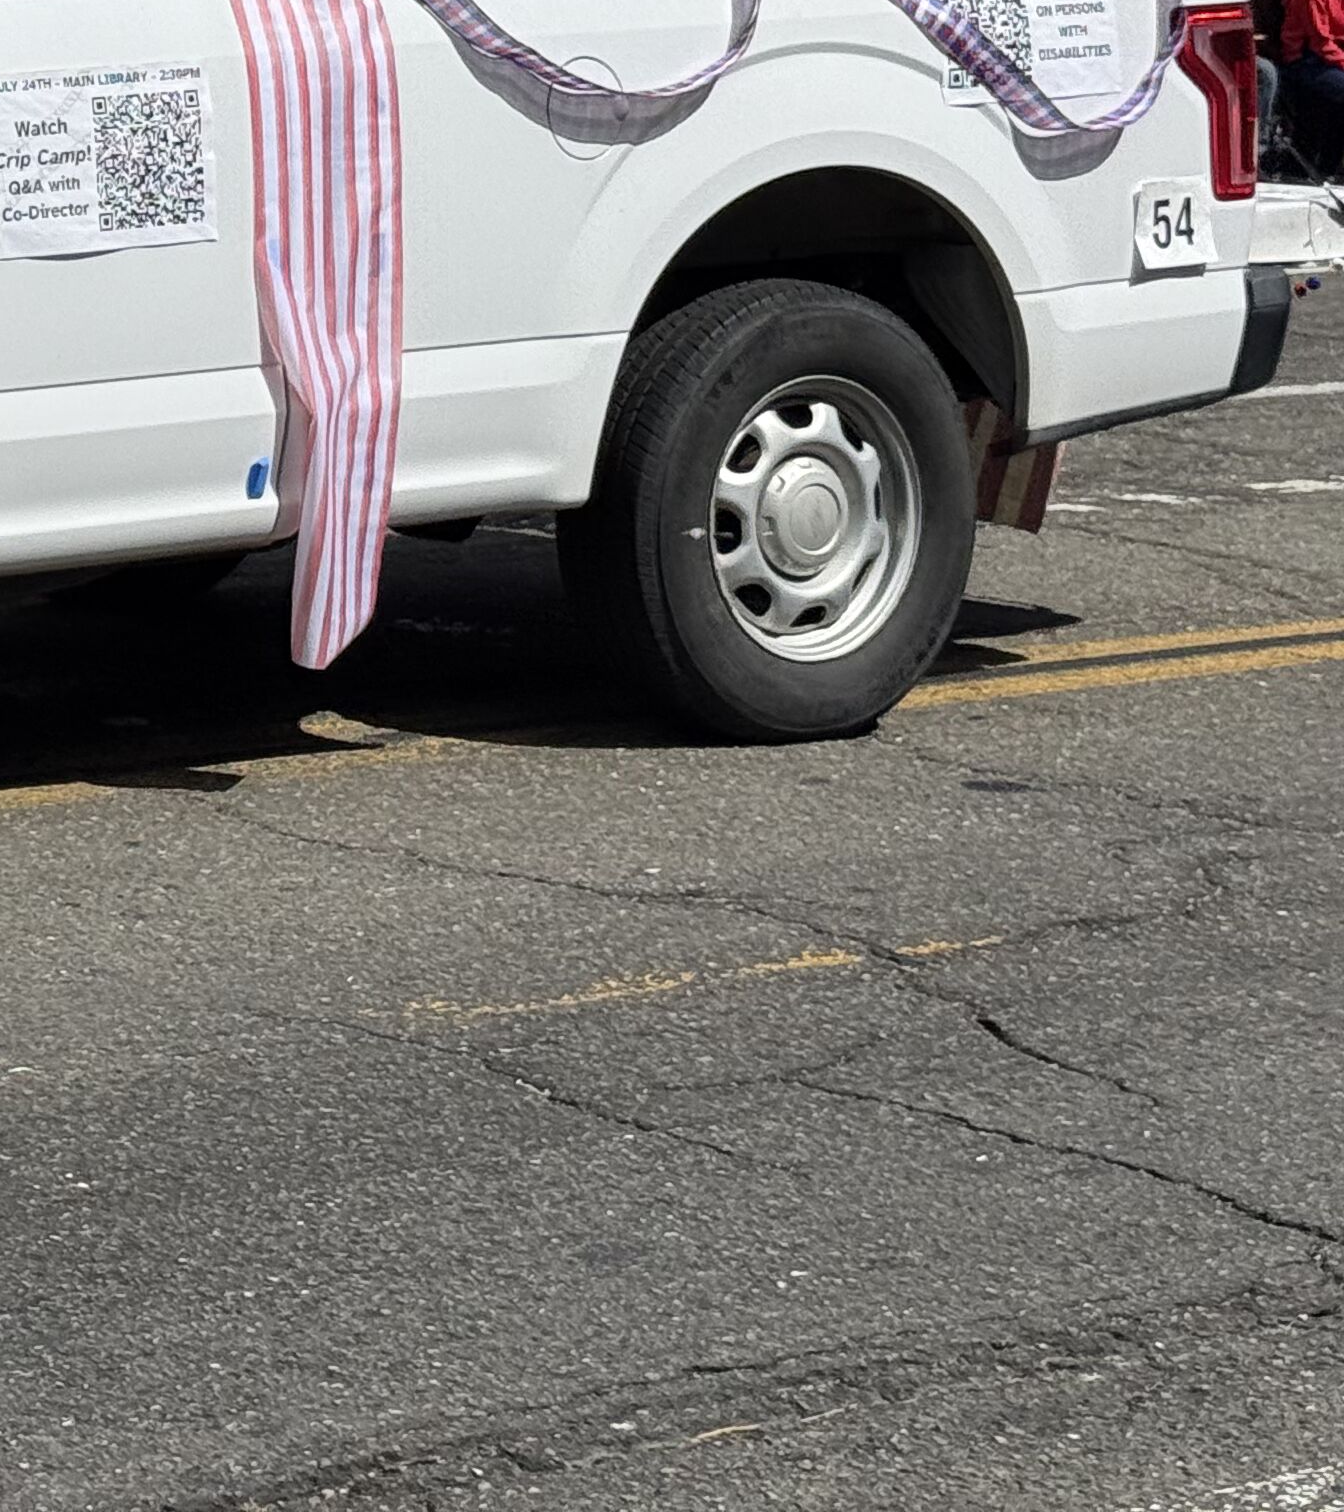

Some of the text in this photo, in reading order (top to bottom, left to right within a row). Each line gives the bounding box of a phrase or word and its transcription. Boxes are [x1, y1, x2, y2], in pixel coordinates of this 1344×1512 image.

[1035, 1, 1106, 17] ON PERSONS
[1057, 25, 1088, 38] WITH
[1038, 43, 1113, 61] DISABILITIES
[21, 78, 52, 90] 24TH
[62, 73, 95, 88] MAIN
[97, 70, 148, 86] LIBRARY
[14, 118, 68, 138] Watch
[37, 145, 92, 167] Camp!
[8, 175, 81, 196] Q&A with
[1, 203, 90, 223] Co-Director
[1151, 196, 1195, 250] 54
